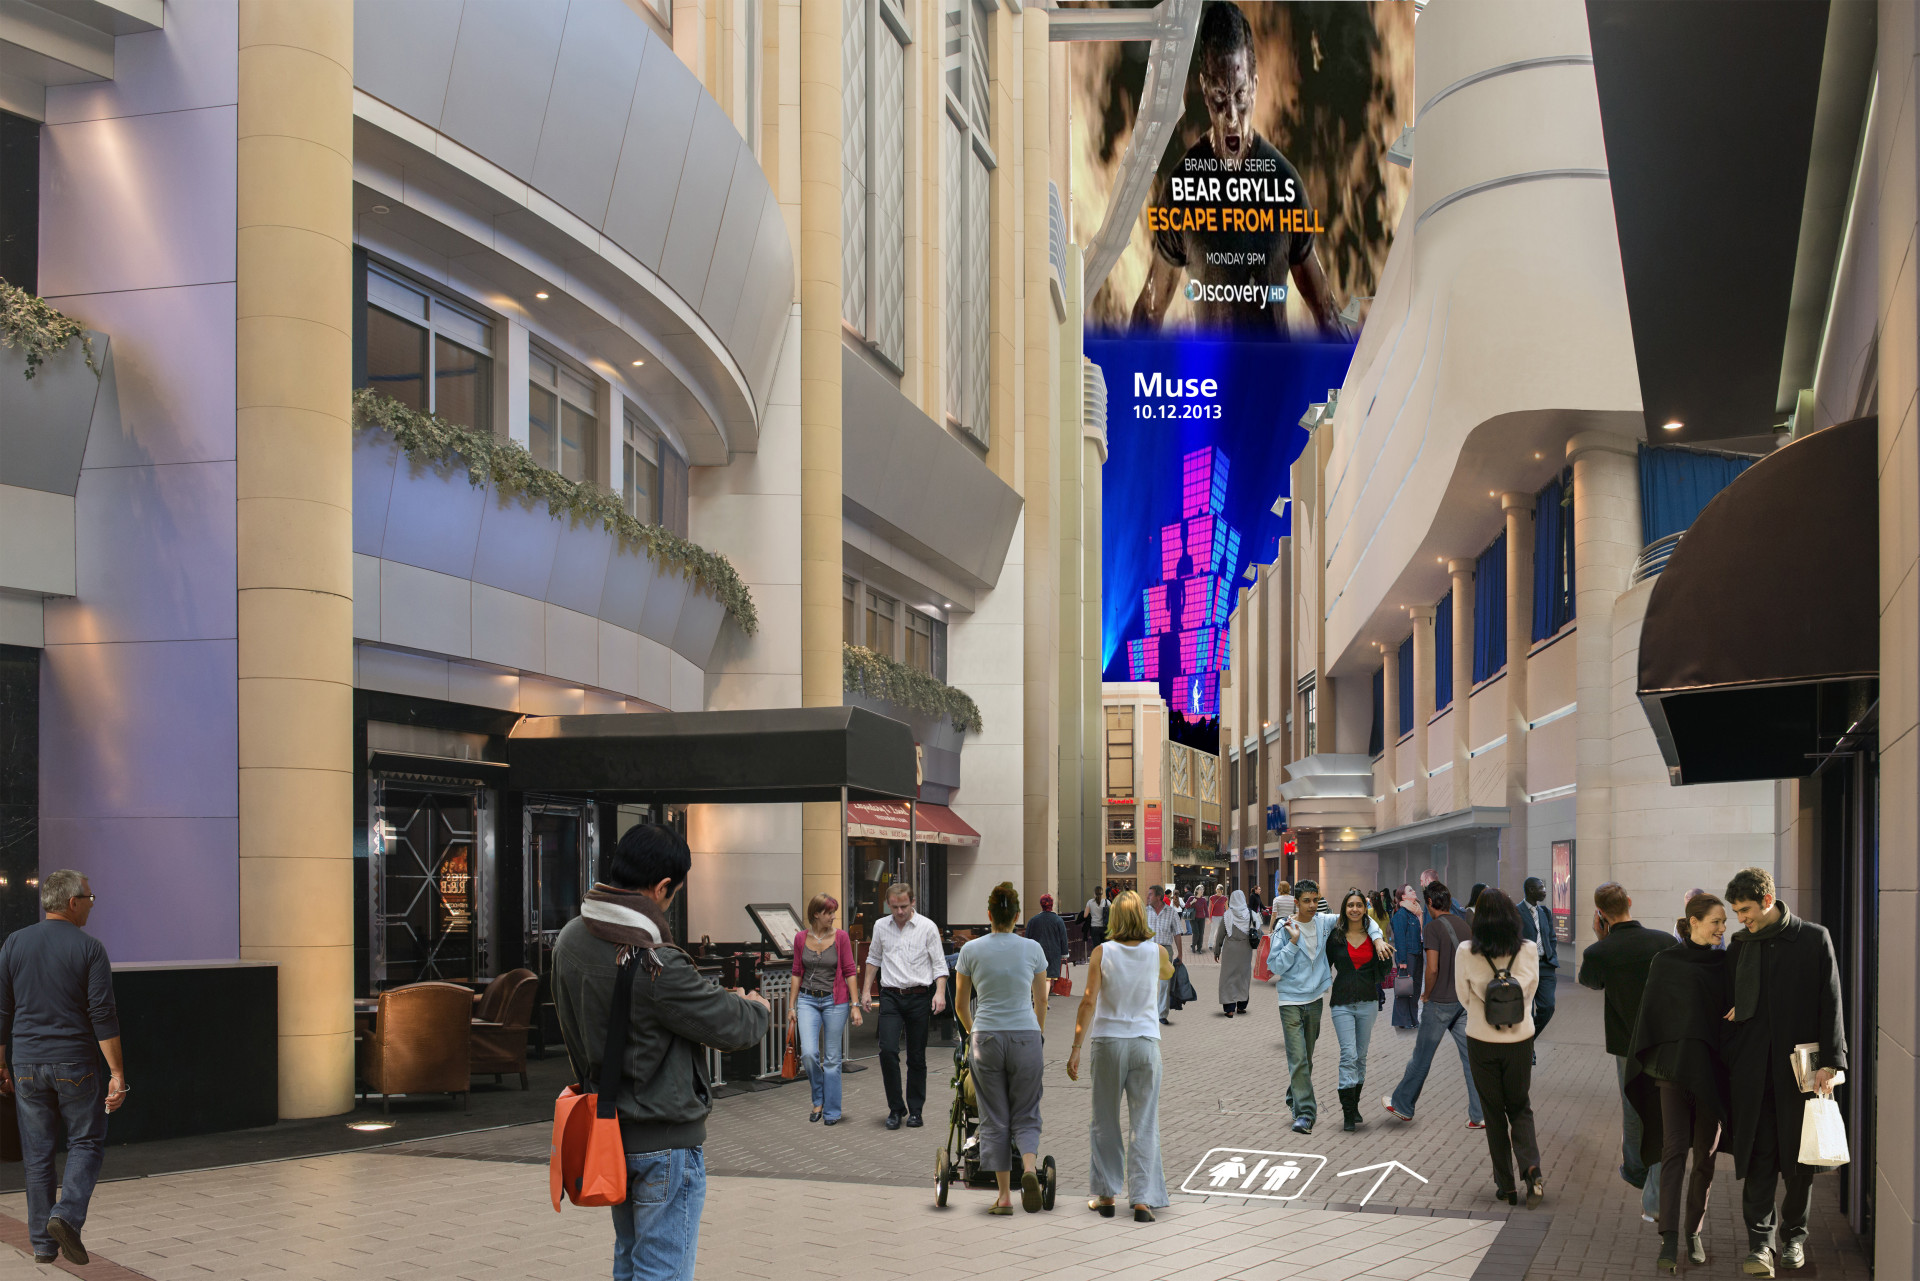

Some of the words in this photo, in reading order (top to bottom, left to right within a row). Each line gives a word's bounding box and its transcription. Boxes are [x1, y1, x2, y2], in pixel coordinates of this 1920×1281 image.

[1184, 158, 1218, 172] BRAND
[1220, 158, 1242, 172] NEW
[1244, 158, 1277, 173] SERIES
[1171, 177, 1222, 201] BEAR
[1226, 177, 1296, 202] GRYLLS
[1147, 207, 1218, 231] ESCAPE
[1222, 208, 1274, 232] FROM
[1279, 208, 1325, 233] HELL
[1206, 252, 1246, 265] MONDAY
[1247, 253, 1266, 265] 9PM
[1190, 279, 1269, 309] Discovery
[1271, 287, 1286, 300] HD
[1134, 372, 1218, 398] Muse
[1133, 404, 1222, 419] 10.12.2013
